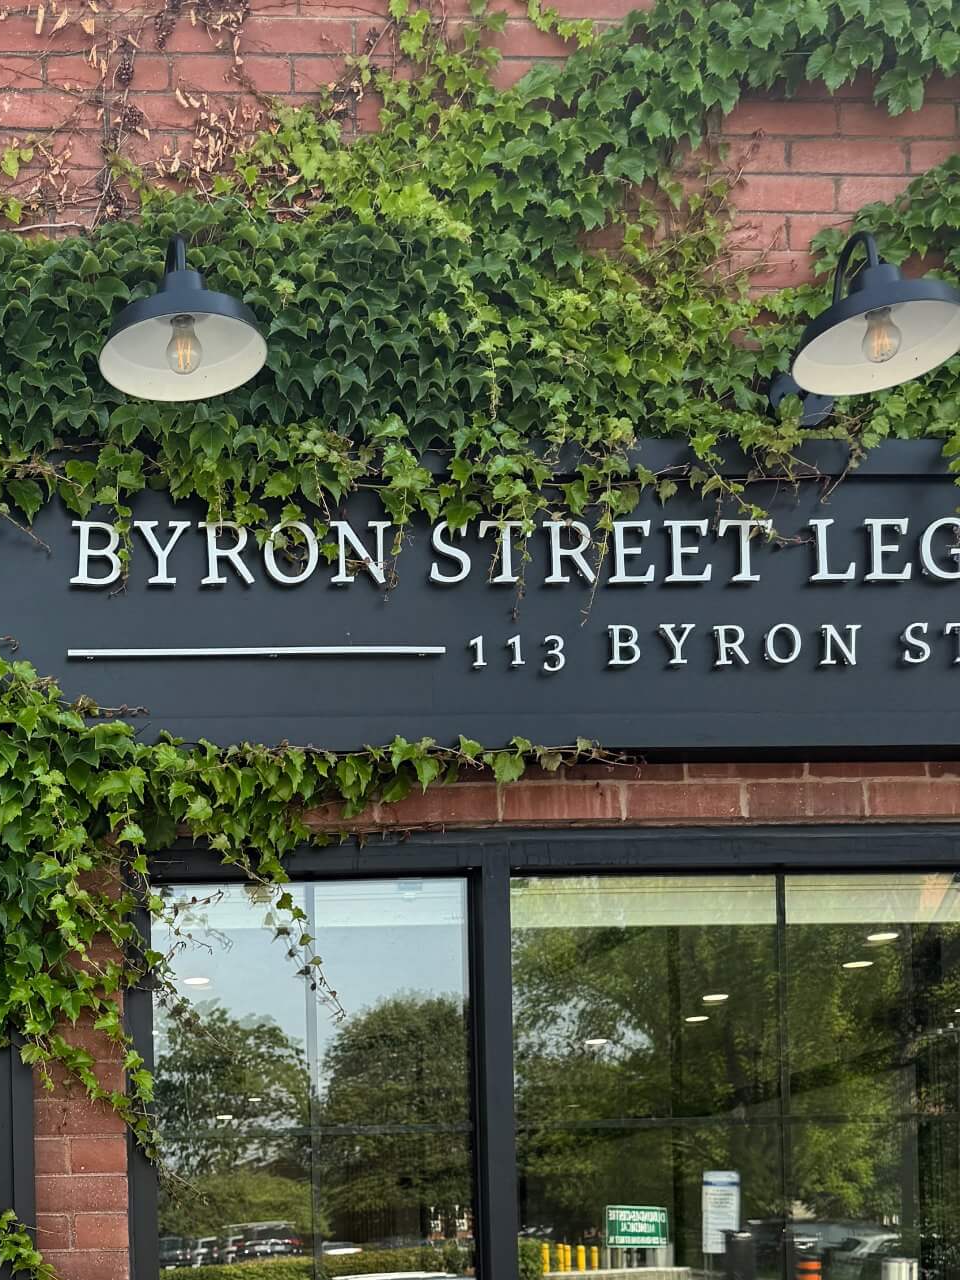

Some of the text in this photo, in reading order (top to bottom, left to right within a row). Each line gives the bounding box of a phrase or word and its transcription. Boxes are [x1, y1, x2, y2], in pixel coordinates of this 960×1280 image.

[69, 517, 960, 585] BYRON STREET LEG
[469, 634, 566, 672] 113
[606, 623, 862, 666] BYRON
